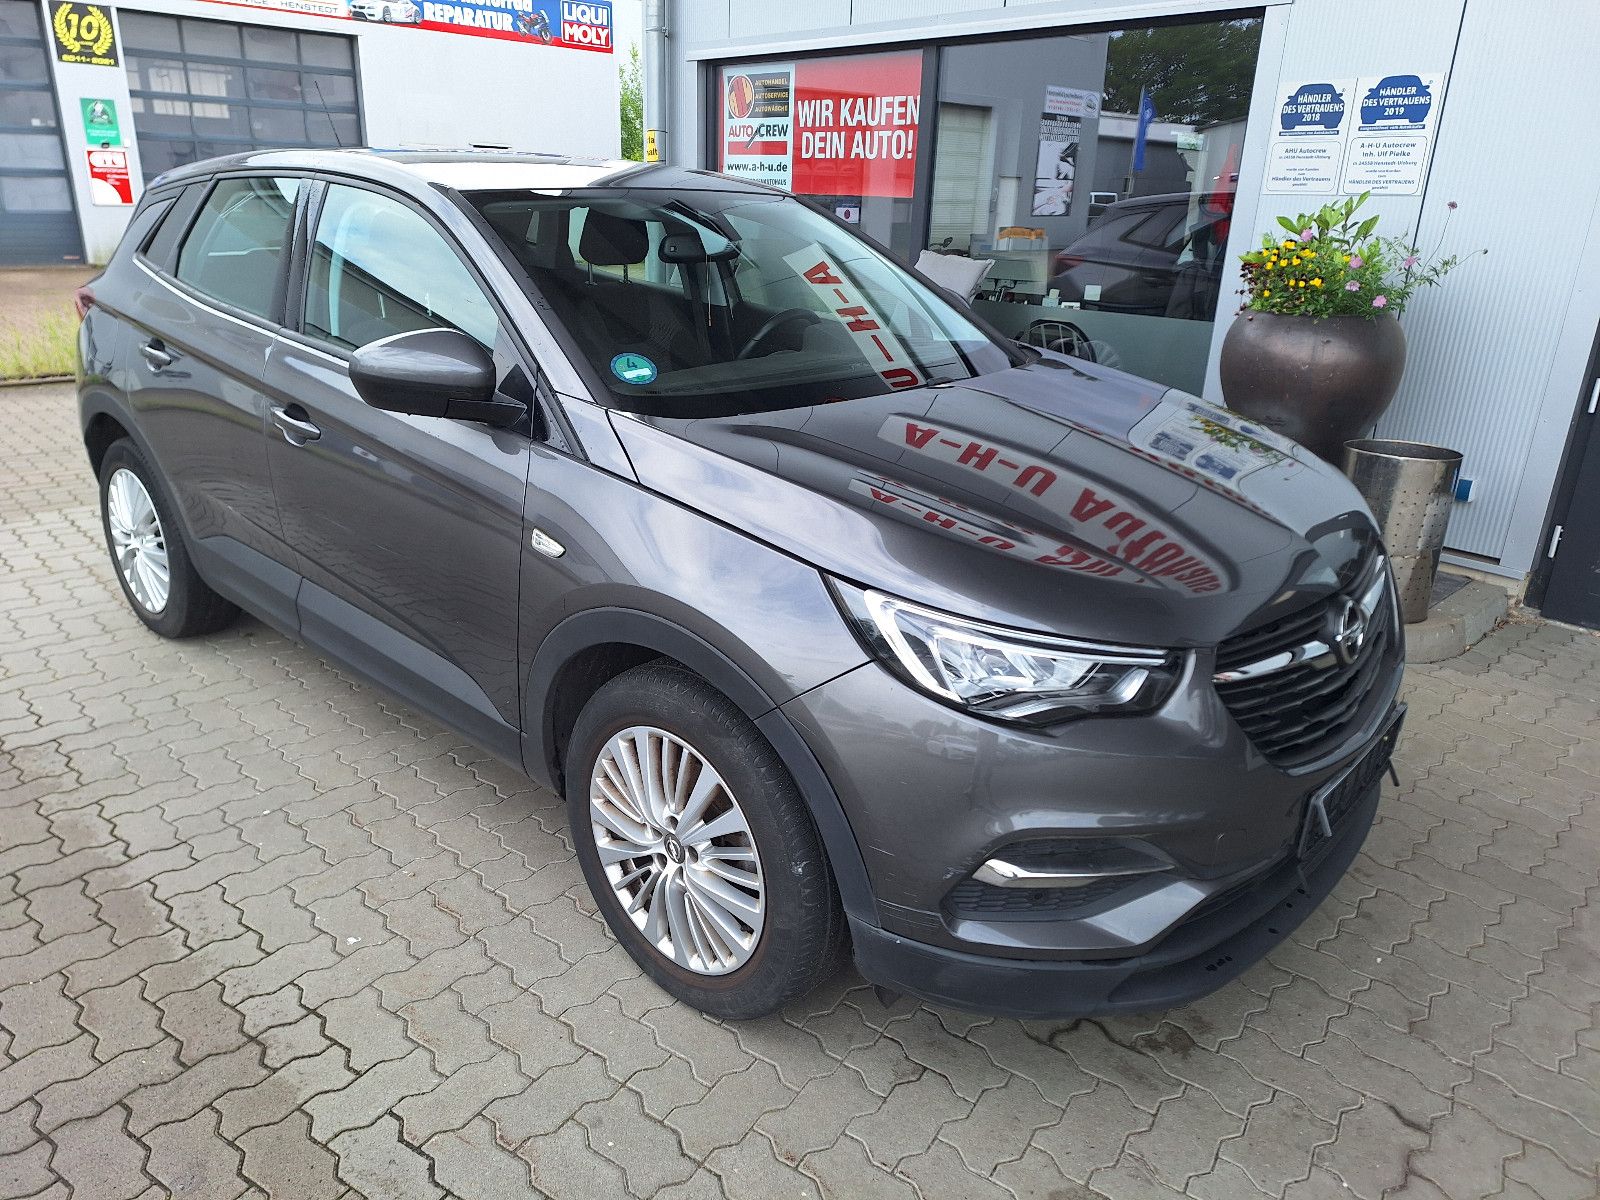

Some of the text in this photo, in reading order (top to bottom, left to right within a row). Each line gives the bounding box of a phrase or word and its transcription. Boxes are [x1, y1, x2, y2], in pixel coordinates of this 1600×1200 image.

[280, 1, 339, 14] HENSTEDT
[423, 1, 514, 32] REPARATUR
[563, 2, 608, 26] LIQUI
[66, 13, 100, 41] 10
[563, 22, 609, 46] MOLY
[1379, 86, 1417, 97] HÄNDLER
[1297, 93, 1332, 104] HÄNDLER
[1363, 96, 1430, 107] DES VERTRAUENS
[797, 95, 920, 128] WIR KAUFEN
[1282, 103, 1344, 114] DES VERTRAUENS
[1383, 106, 1405, 116] 2019
[1301, 113, 1321, 122] 2018
[728, 123, 789, 138] AUTO CREW
[801, 130, 914, 160] DEIN AUTO!
[727, 161, 788, 173] www.a-h-u.de
[626, 357, 638, 368] 4
